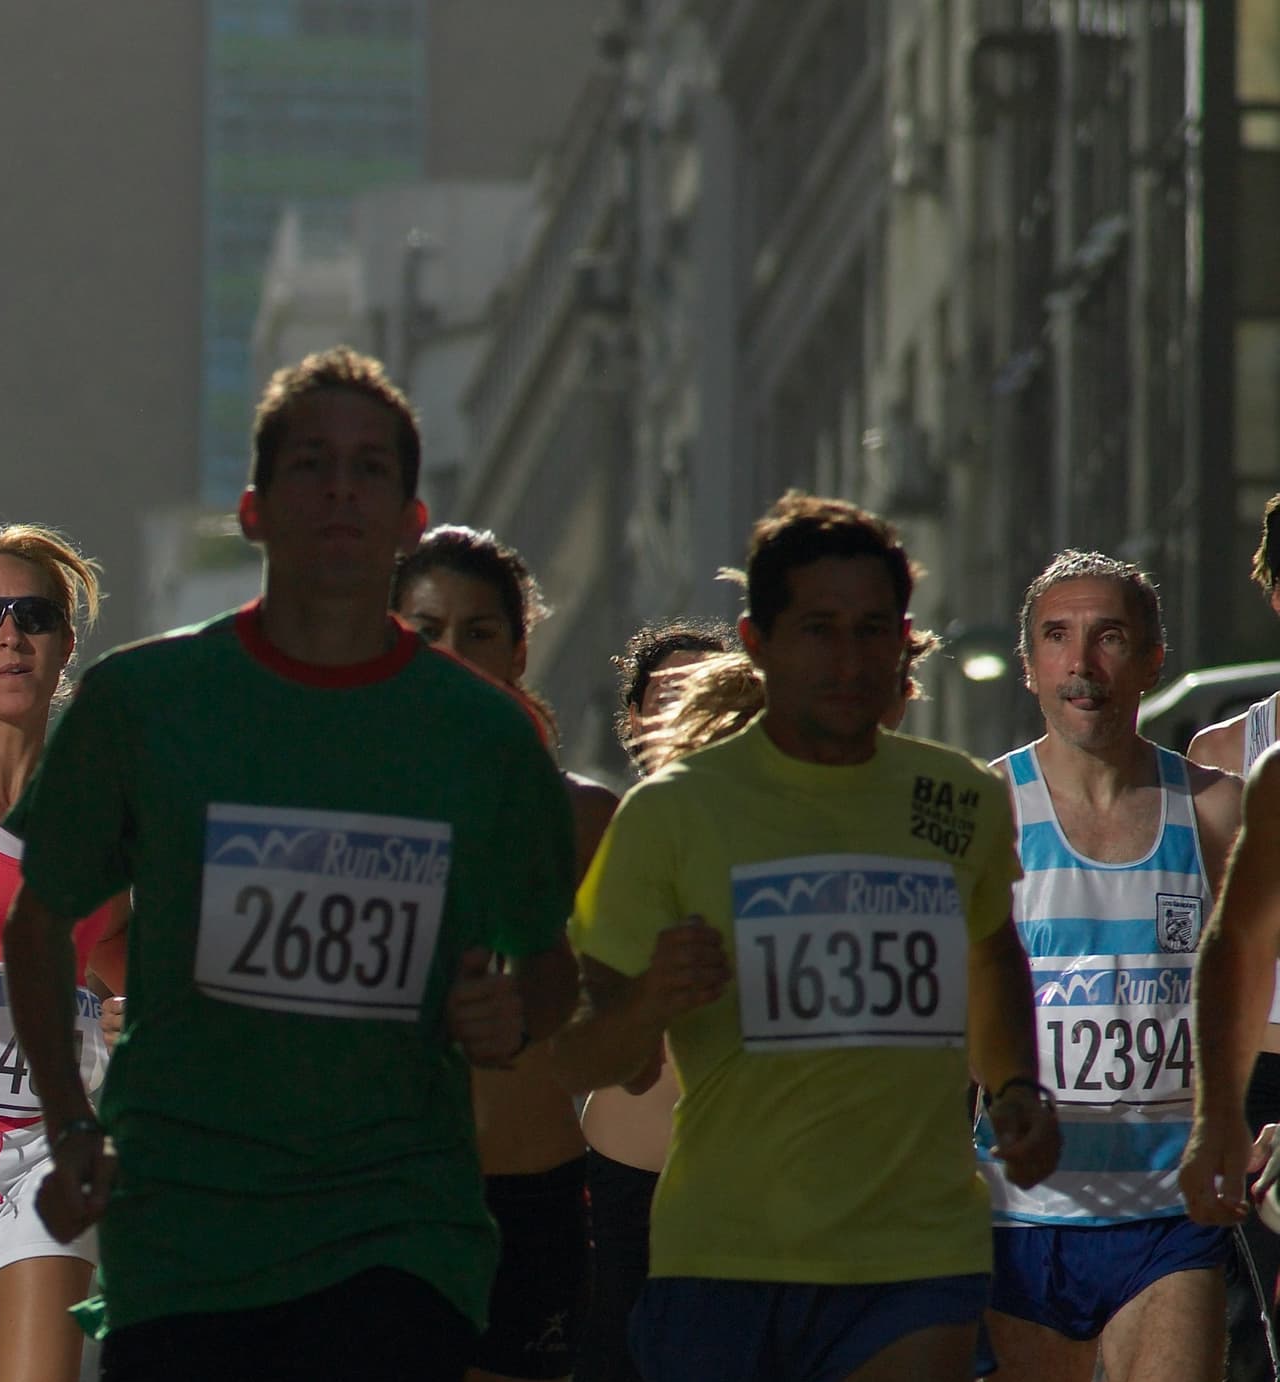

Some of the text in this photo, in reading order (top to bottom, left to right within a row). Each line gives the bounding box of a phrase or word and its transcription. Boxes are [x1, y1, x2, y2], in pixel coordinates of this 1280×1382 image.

[321, 832, 450, 887] RunStyle
[911, 815, 972, 858] 2007
[845, 872, 960, 915] RunStyle
[228, 885, 420, 990] 26831
[754, 930, 940, 1021] 16358
[1047, 1018, 1195, 1090] 12394
